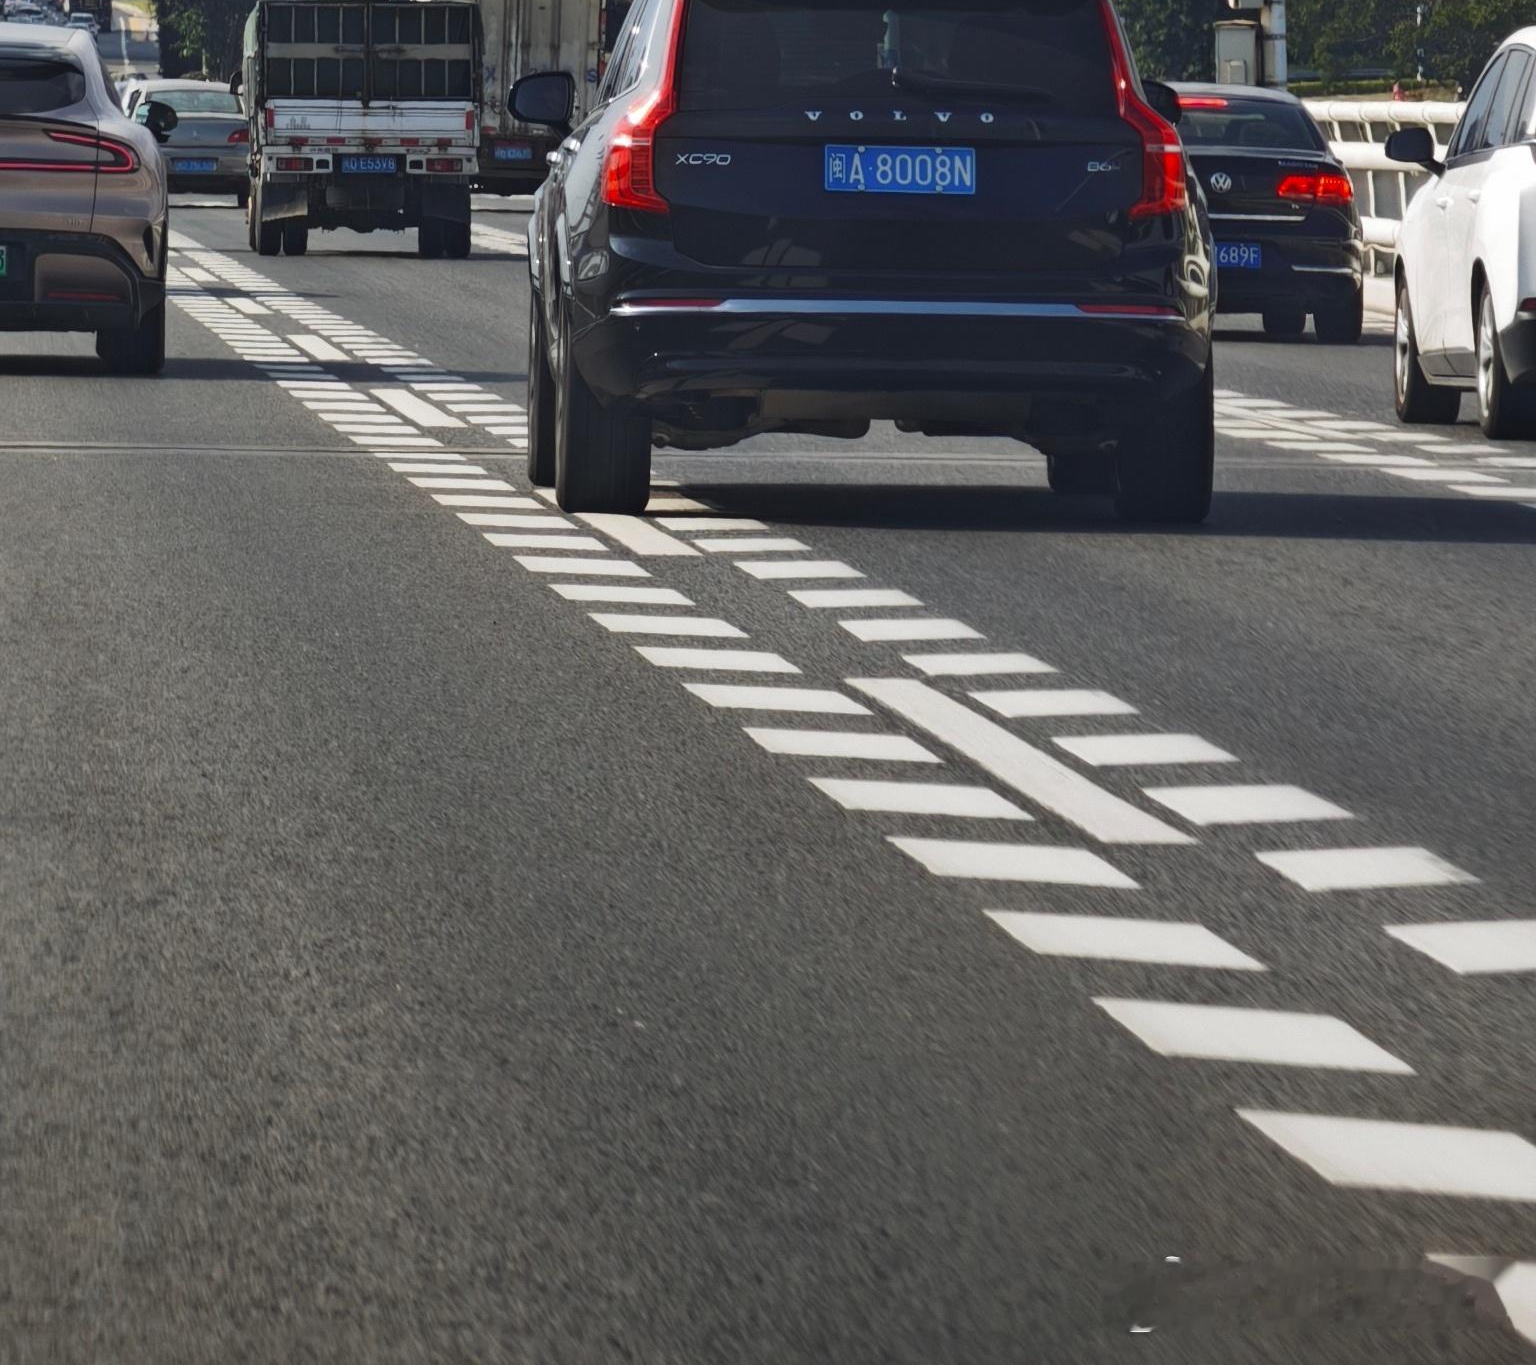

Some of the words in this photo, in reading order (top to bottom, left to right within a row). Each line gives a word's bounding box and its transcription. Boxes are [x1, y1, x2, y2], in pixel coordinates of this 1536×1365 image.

[805, 110, 994, 123] VOLVO
[675, 153, 731, 165] XC90
[1215, 245, 1259, 265] 689F
